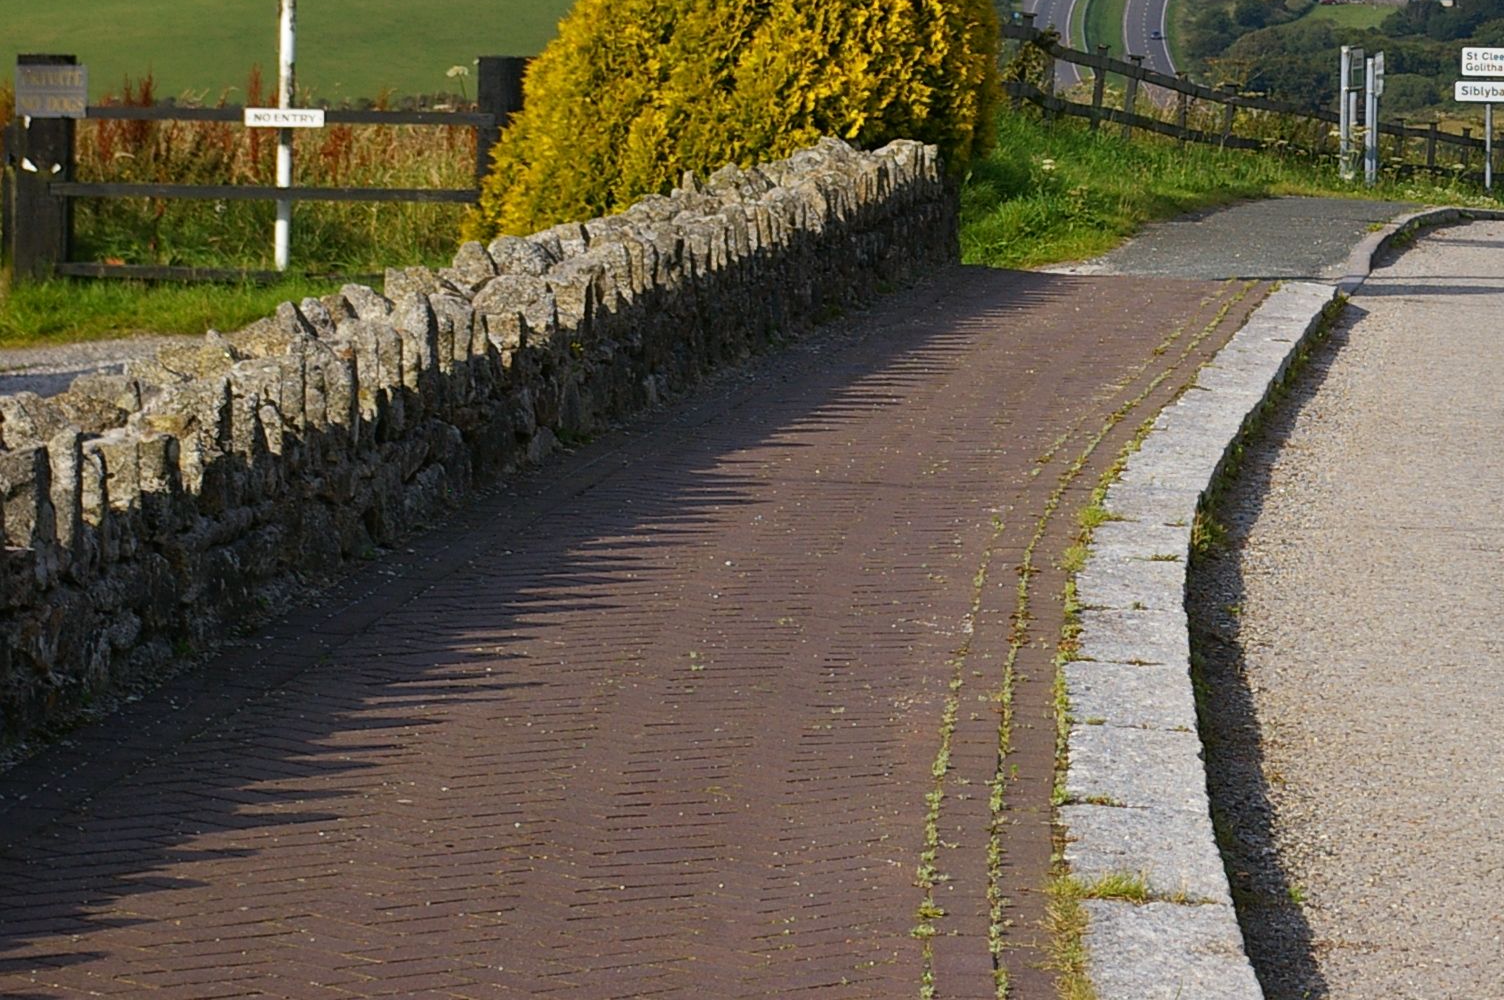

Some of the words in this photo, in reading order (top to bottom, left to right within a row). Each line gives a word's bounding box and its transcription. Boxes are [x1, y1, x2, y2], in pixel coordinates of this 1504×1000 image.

[1466, 51, 1478, 61] St
[1465, 62, 1503, 72] Golitha
[253, 113, 271, 122] NO
[274, 113, 316, 122] ENTRY
